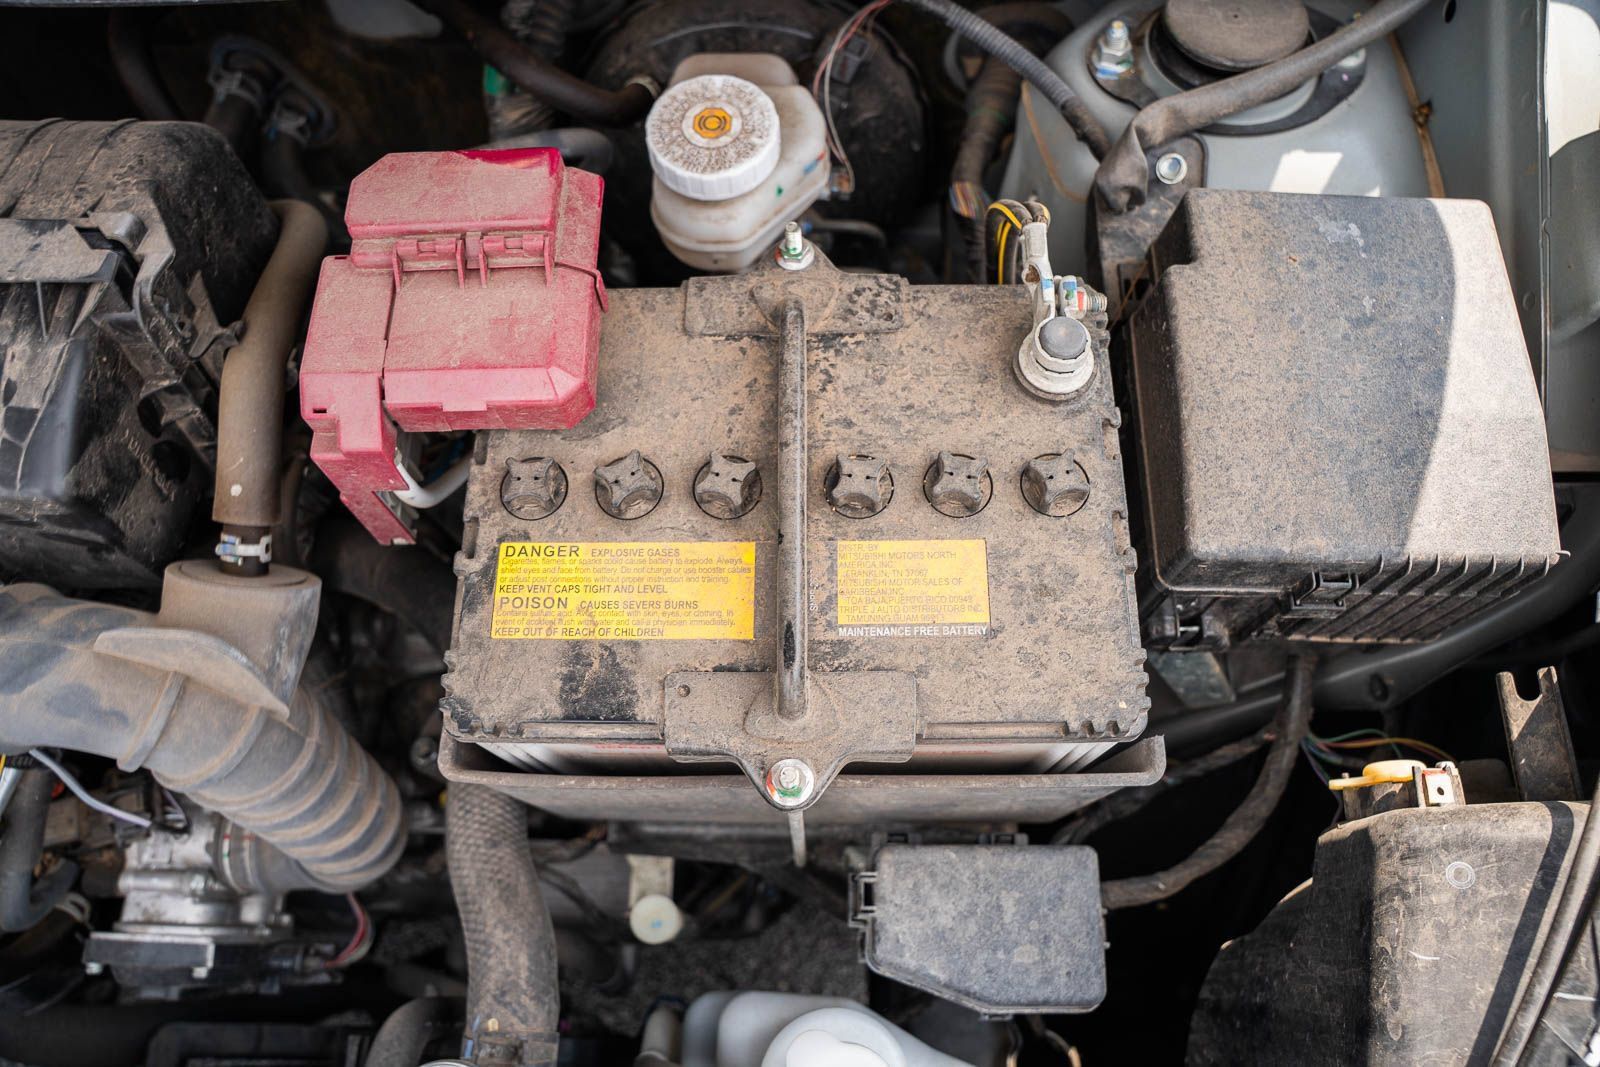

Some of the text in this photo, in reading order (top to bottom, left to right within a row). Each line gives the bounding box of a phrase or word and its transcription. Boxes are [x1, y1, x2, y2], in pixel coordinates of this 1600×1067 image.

[505, 545, 680, 557] DANGER EXPLOSIVE GASES
[716, 557, 743, 565] Always
[647, 567, 672, 575] charge
[509, 575, 530, 584] adjust
[532, 576, 548, 584] post
[499, 585, 668, 593] KEEP VENT CAPS TIGHT AND LEVEL
[499, 596, 699, 609] POISON CAUSES SEVERS BURNS
[615, 618, 630, 626] and
[495, 628, 664, 636] KEEP OUT OF REACH OF CHILDREN
[838, 626, 987, 636] MAINTENANCE FREE BATTERY
